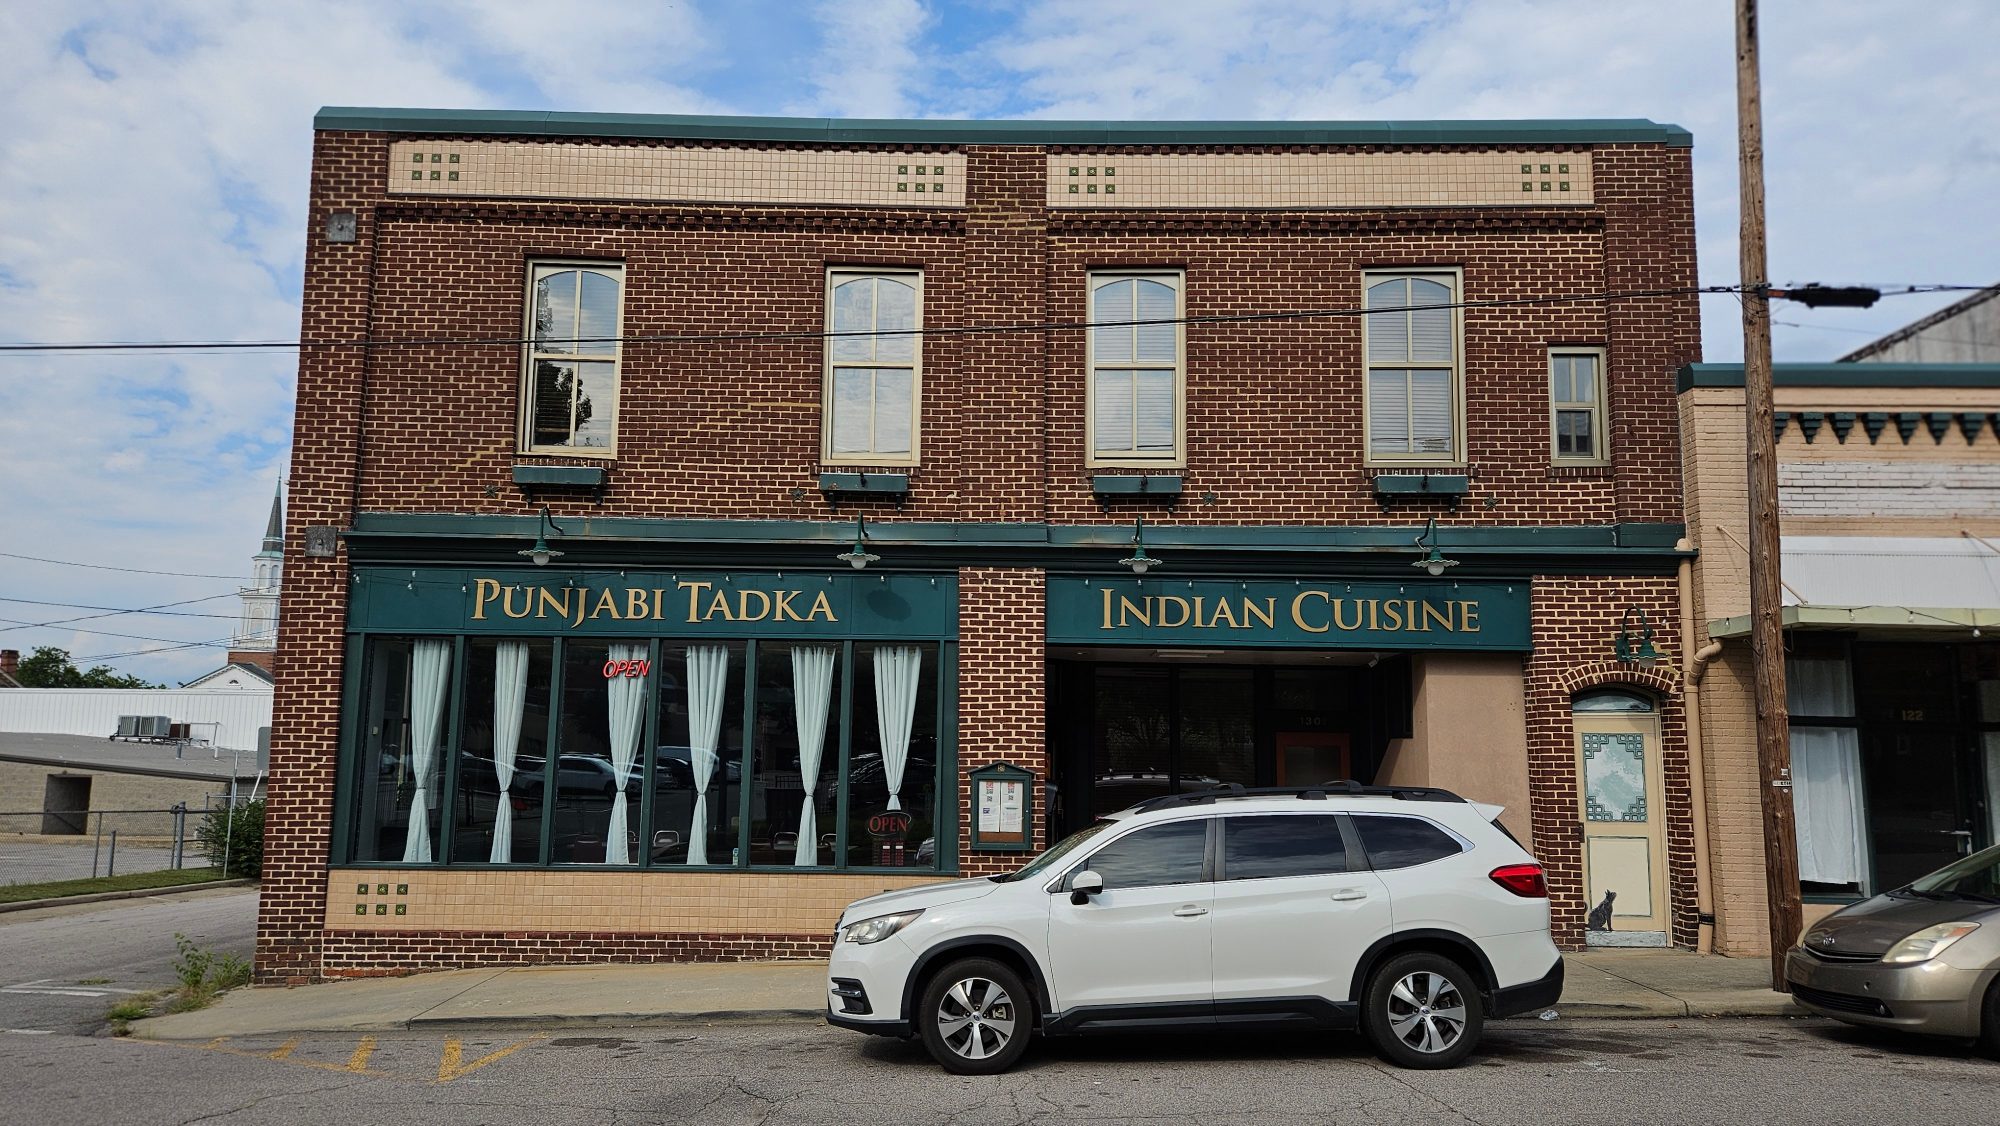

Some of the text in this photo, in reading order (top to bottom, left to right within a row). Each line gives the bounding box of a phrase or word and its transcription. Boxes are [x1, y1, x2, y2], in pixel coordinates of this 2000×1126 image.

[470, 578, 839, 629] PUNJABI TADKA
[1100, 588, 1481, 633] INDIAN CUISINE
[603, 660, 651, 678] OPEN
[1902, 710, 1924, 721] 122
[869, 816, 907, 832] OPEN
